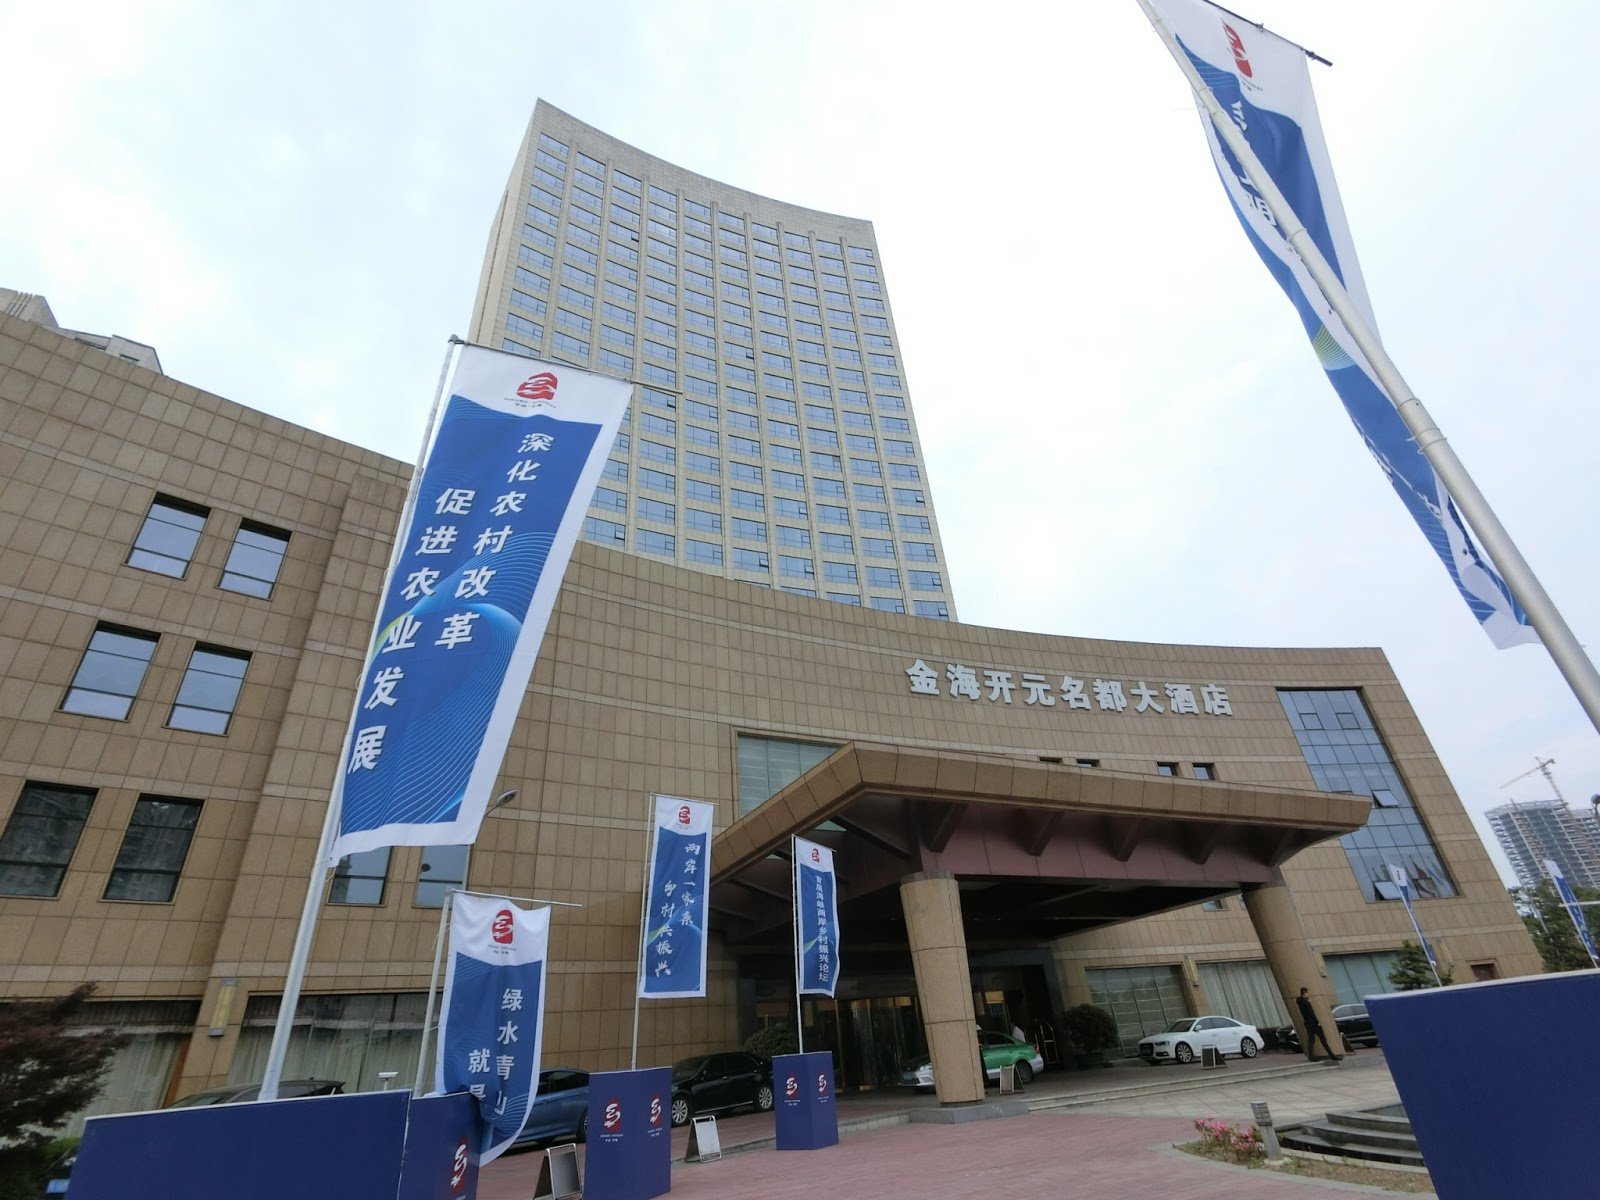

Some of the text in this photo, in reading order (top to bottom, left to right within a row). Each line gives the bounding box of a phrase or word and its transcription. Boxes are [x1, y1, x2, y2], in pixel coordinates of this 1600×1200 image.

[434, 433, 553, 650] 深化农村改革
[347, 488, 475, 775] 促进农业发展
[905, 658, 1234, 716] 金海开元名都大酒店
[655, 880, 677, 977] 乡村共振兴
[680, 843, 701, 926] 两岸一家亲
